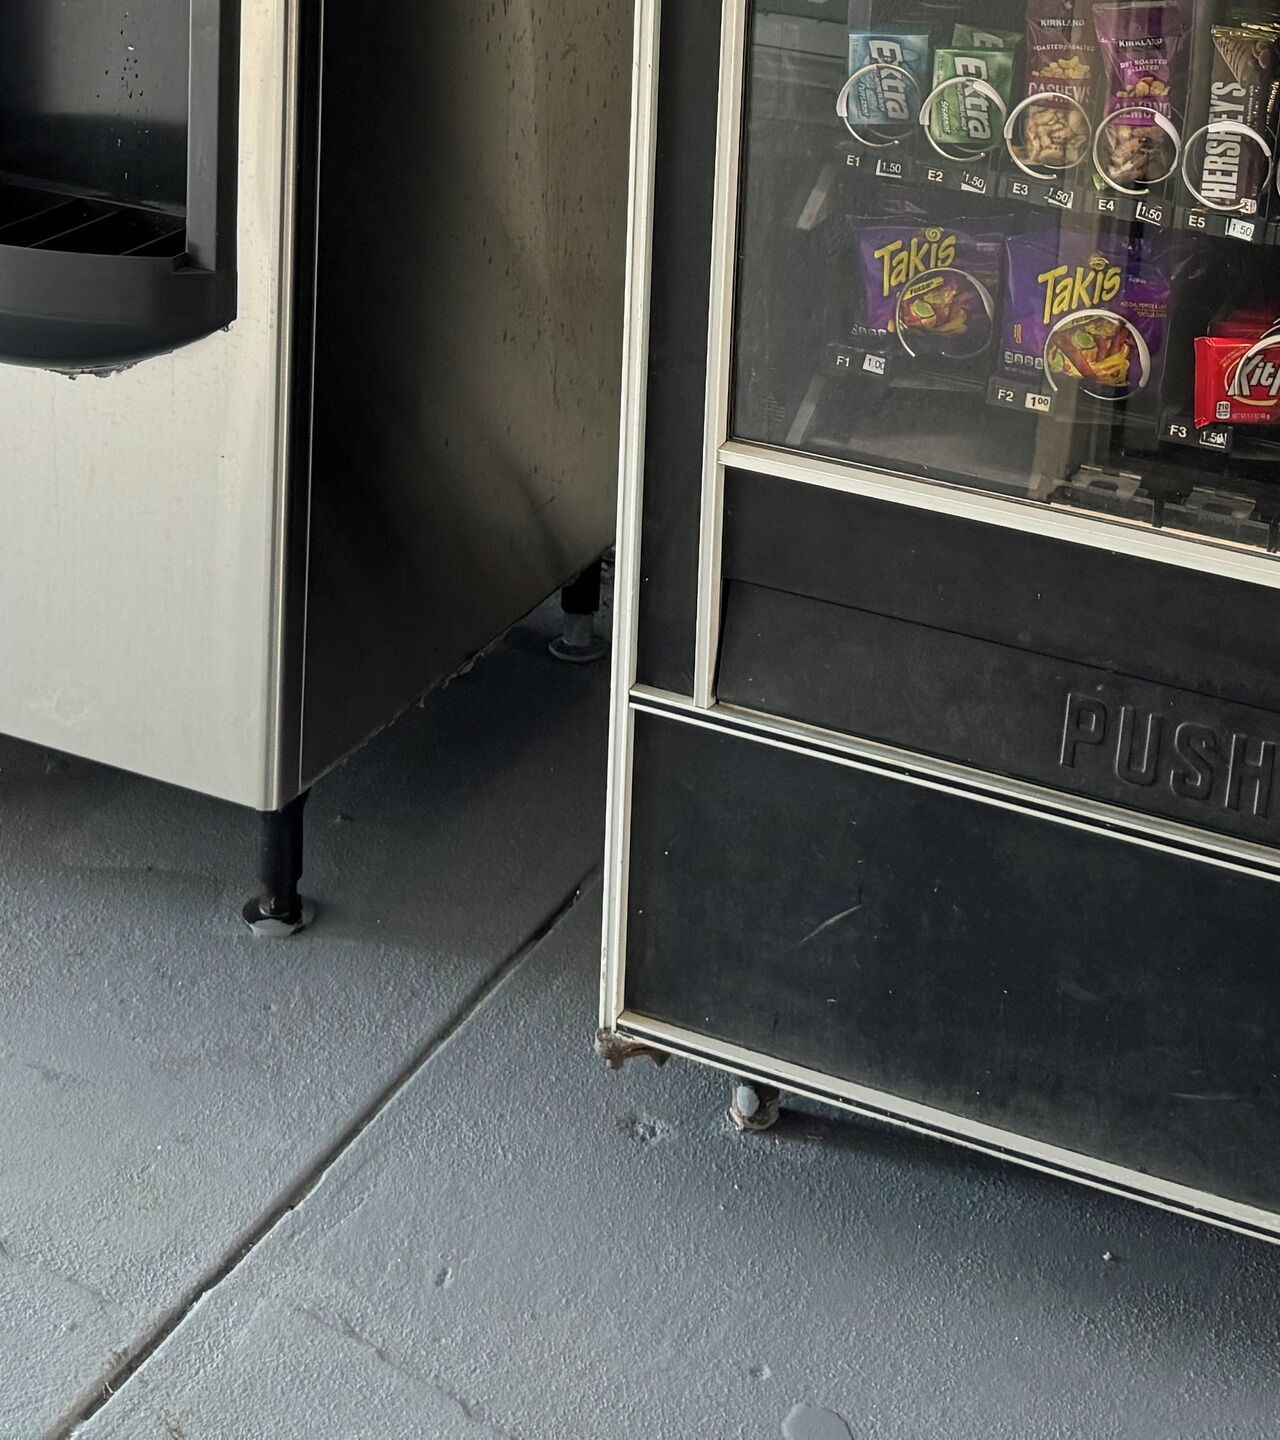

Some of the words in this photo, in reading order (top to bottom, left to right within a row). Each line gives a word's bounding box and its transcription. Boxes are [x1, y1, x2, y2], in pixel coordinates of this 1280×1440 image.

[1040, 18, 1085, 27] KIRKLAND
[1118, 37, 1163, 48] KIRKLAND
[927, 170, 943, 182] E2
[1013, 183, 1028, 195] E3
[1098, 199, 1115, 211] E4
[1189, 216, 1206, 228] E5
[1231, 223, 1252, 236] 1.50
[874, 230, 956, 296] Takis
[1038, 263, 1122, 324] Takis
[998, 389, 1014, 402] F2
[1169, 424, 1187, 439] F3
[1060, 693, 1276, 819] PUSH
